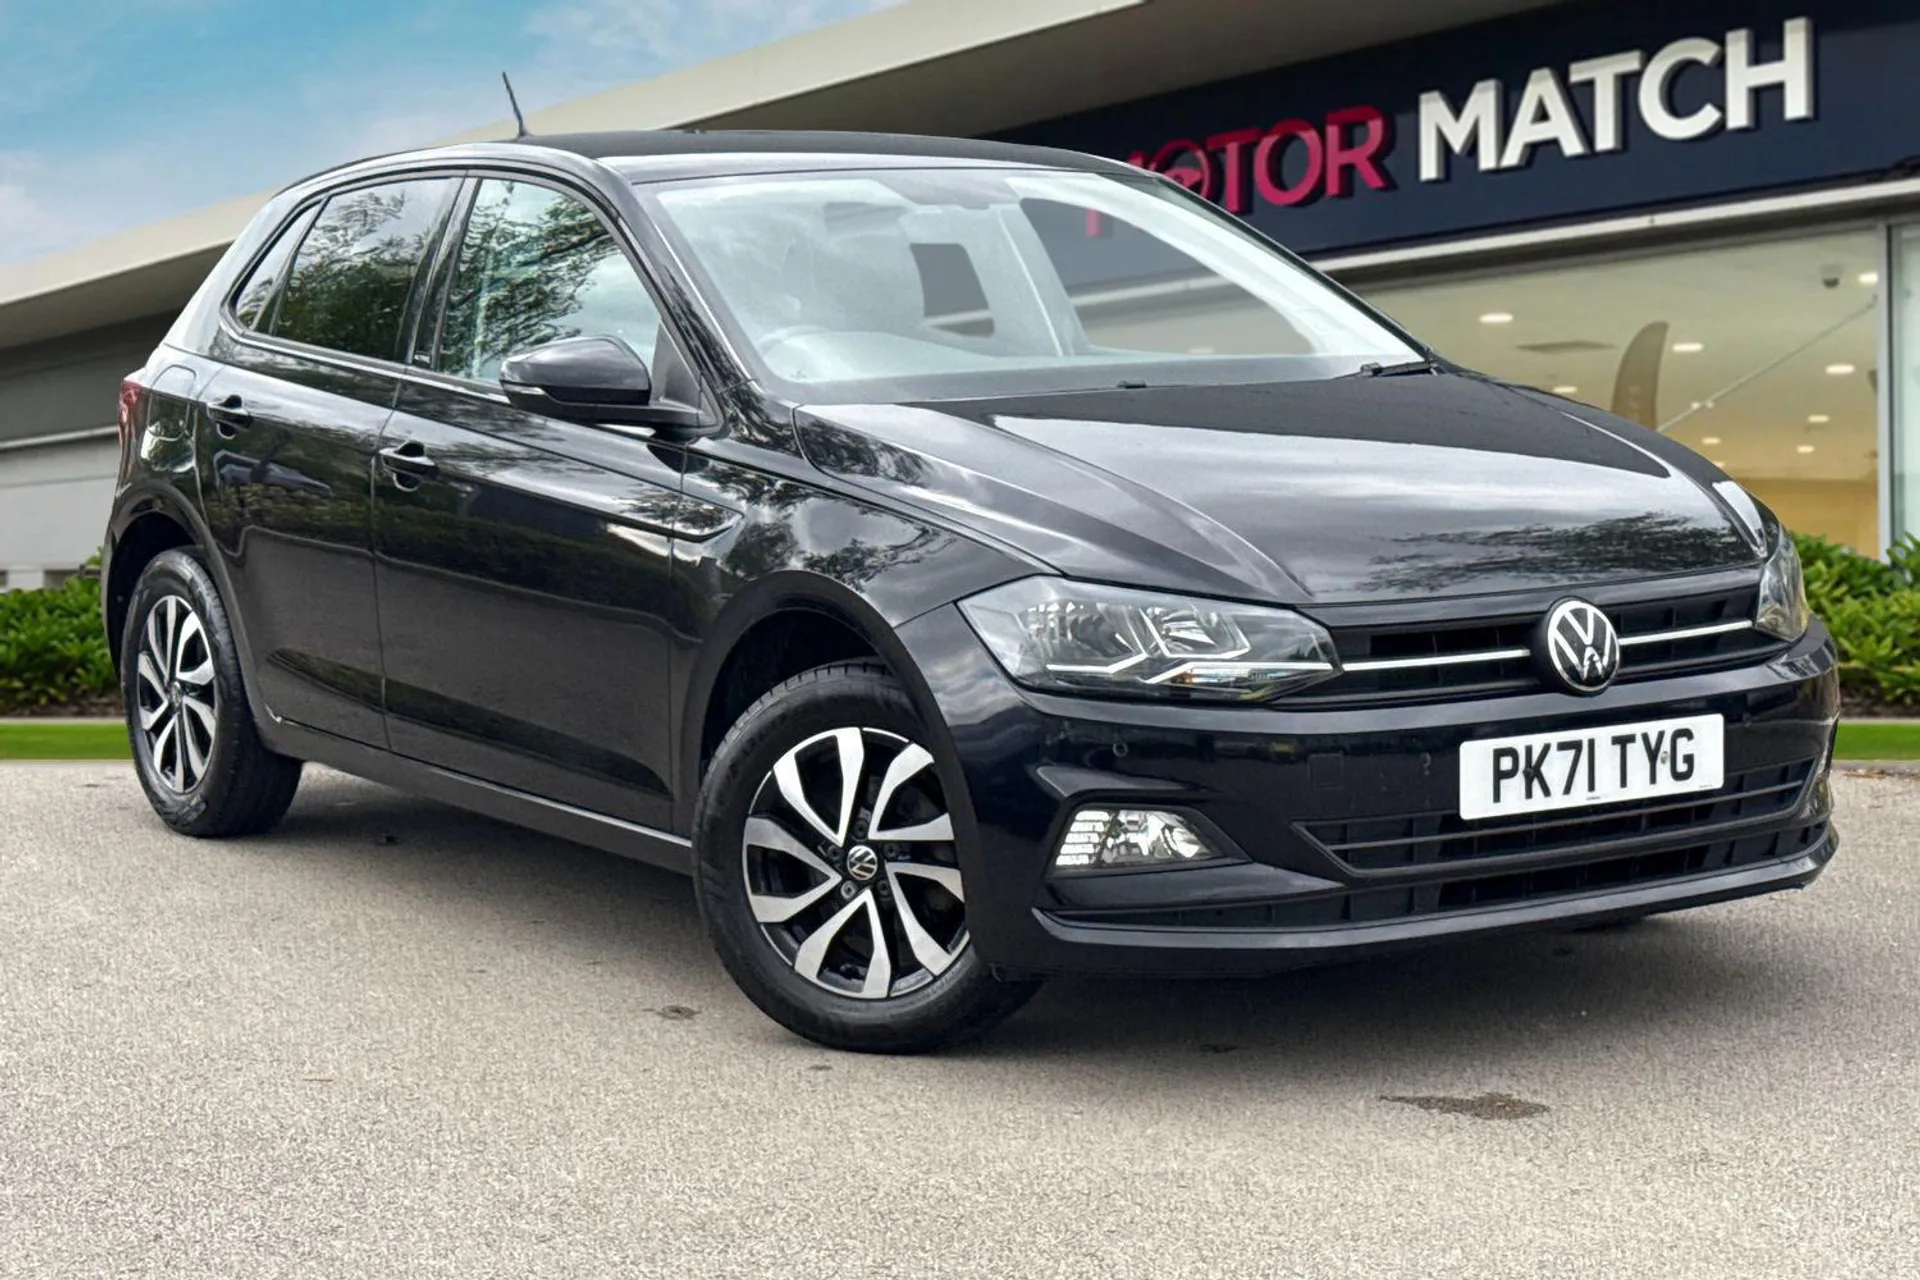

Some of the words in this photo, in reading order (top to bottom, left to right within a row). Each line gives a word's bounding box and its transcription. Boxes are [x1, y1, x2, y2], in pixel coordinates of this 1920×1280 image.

[1419, 16, 1814, 182] MATCH
[1492, 737, 1596, 804] PK71
[1611, 727, 1695, 789] TYG
